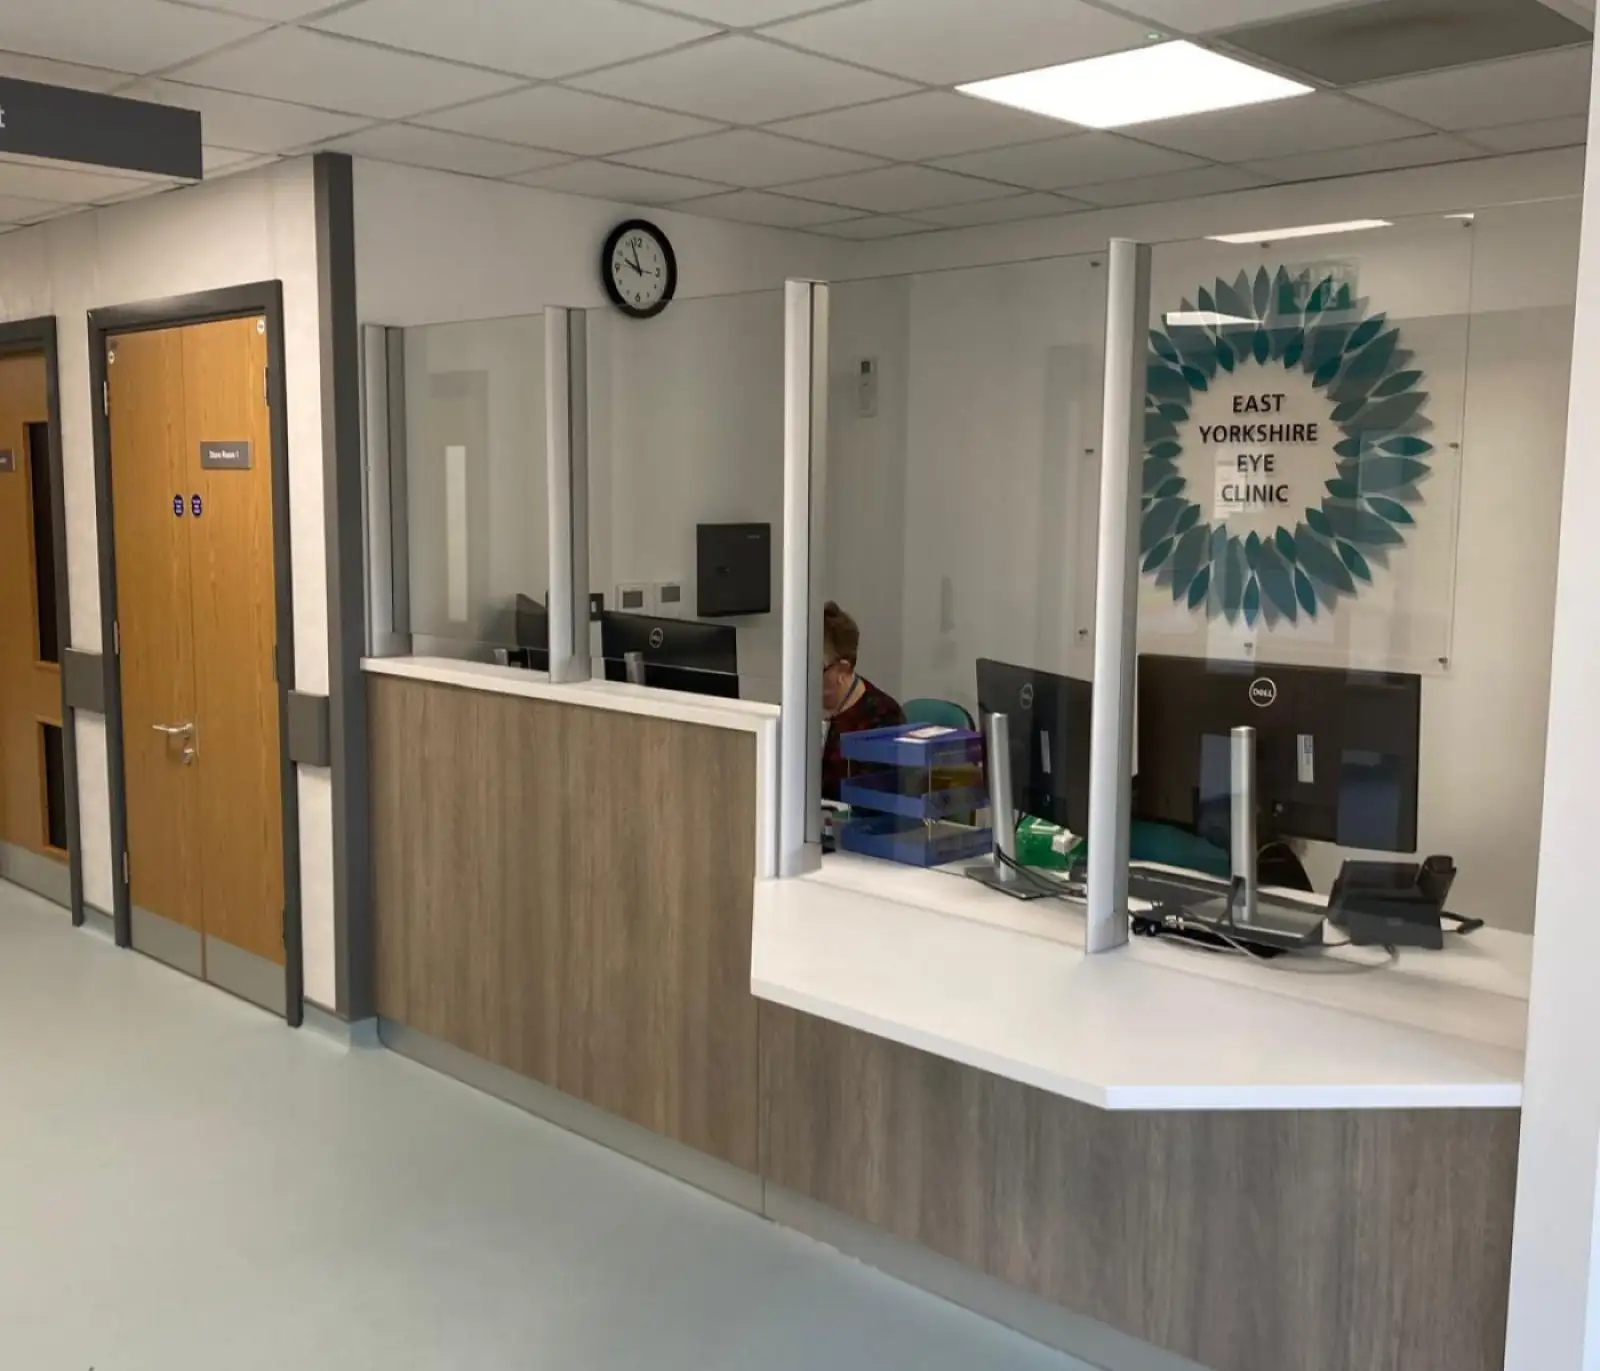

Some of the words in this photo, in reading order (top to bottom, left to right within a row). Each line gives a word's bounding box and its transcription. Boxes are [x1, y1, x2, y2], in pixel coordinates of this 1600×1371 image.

[1232, 393, 1285, 413] EAST
[1199, 423, 1318, 443] YORKSHIRE
[1237, 453, 1275, 473] EYE
[1222, 484, 1289, 503] CLINIC
[1253, 687, 1273, 698] DELL
